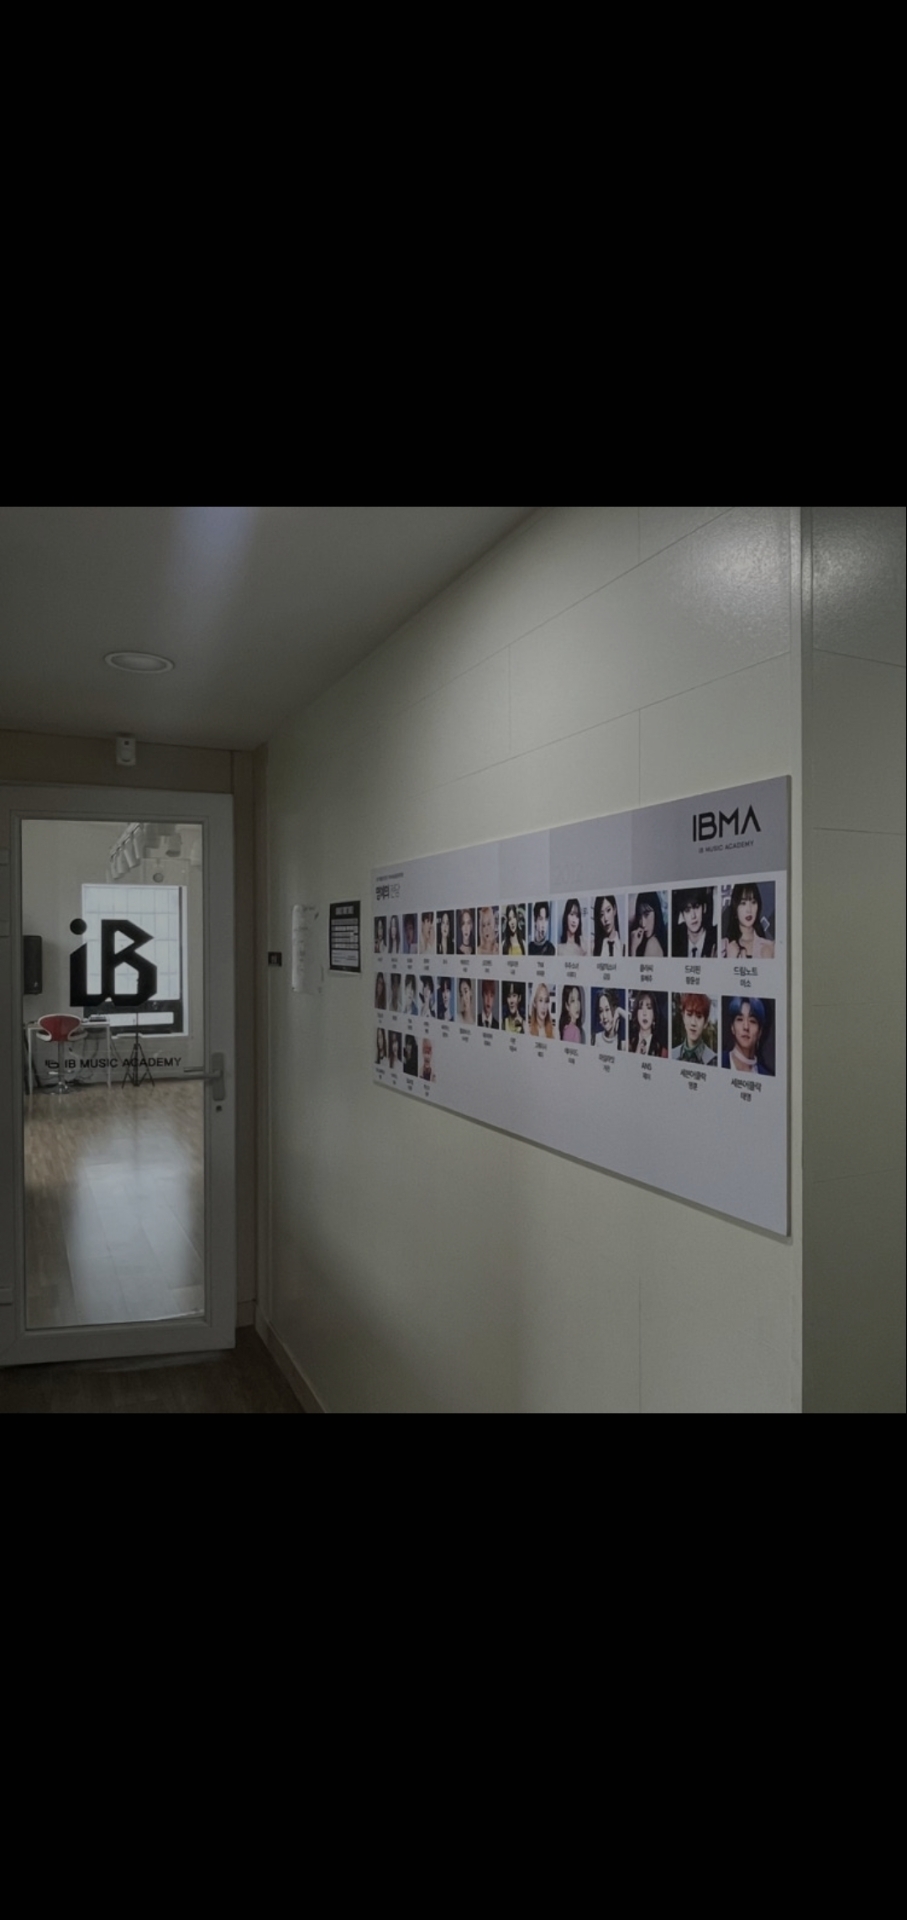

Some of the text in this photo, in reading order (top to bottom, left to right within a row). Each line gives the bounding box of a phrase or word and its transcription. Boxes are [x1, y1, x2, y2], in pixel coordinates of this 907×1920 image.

[693, 804, 761, 842] IBMA
[705, 844, 723, 852] MUSIC
[725, 840, 754, 850] ACADEMY
[733, 966, 758, 976] 드림노트
[64, 1059, 76, 1069] IB
[80, 1058, 118, 1069] MUSIC
[122, 1057, 182, 1068] ACADEMY
